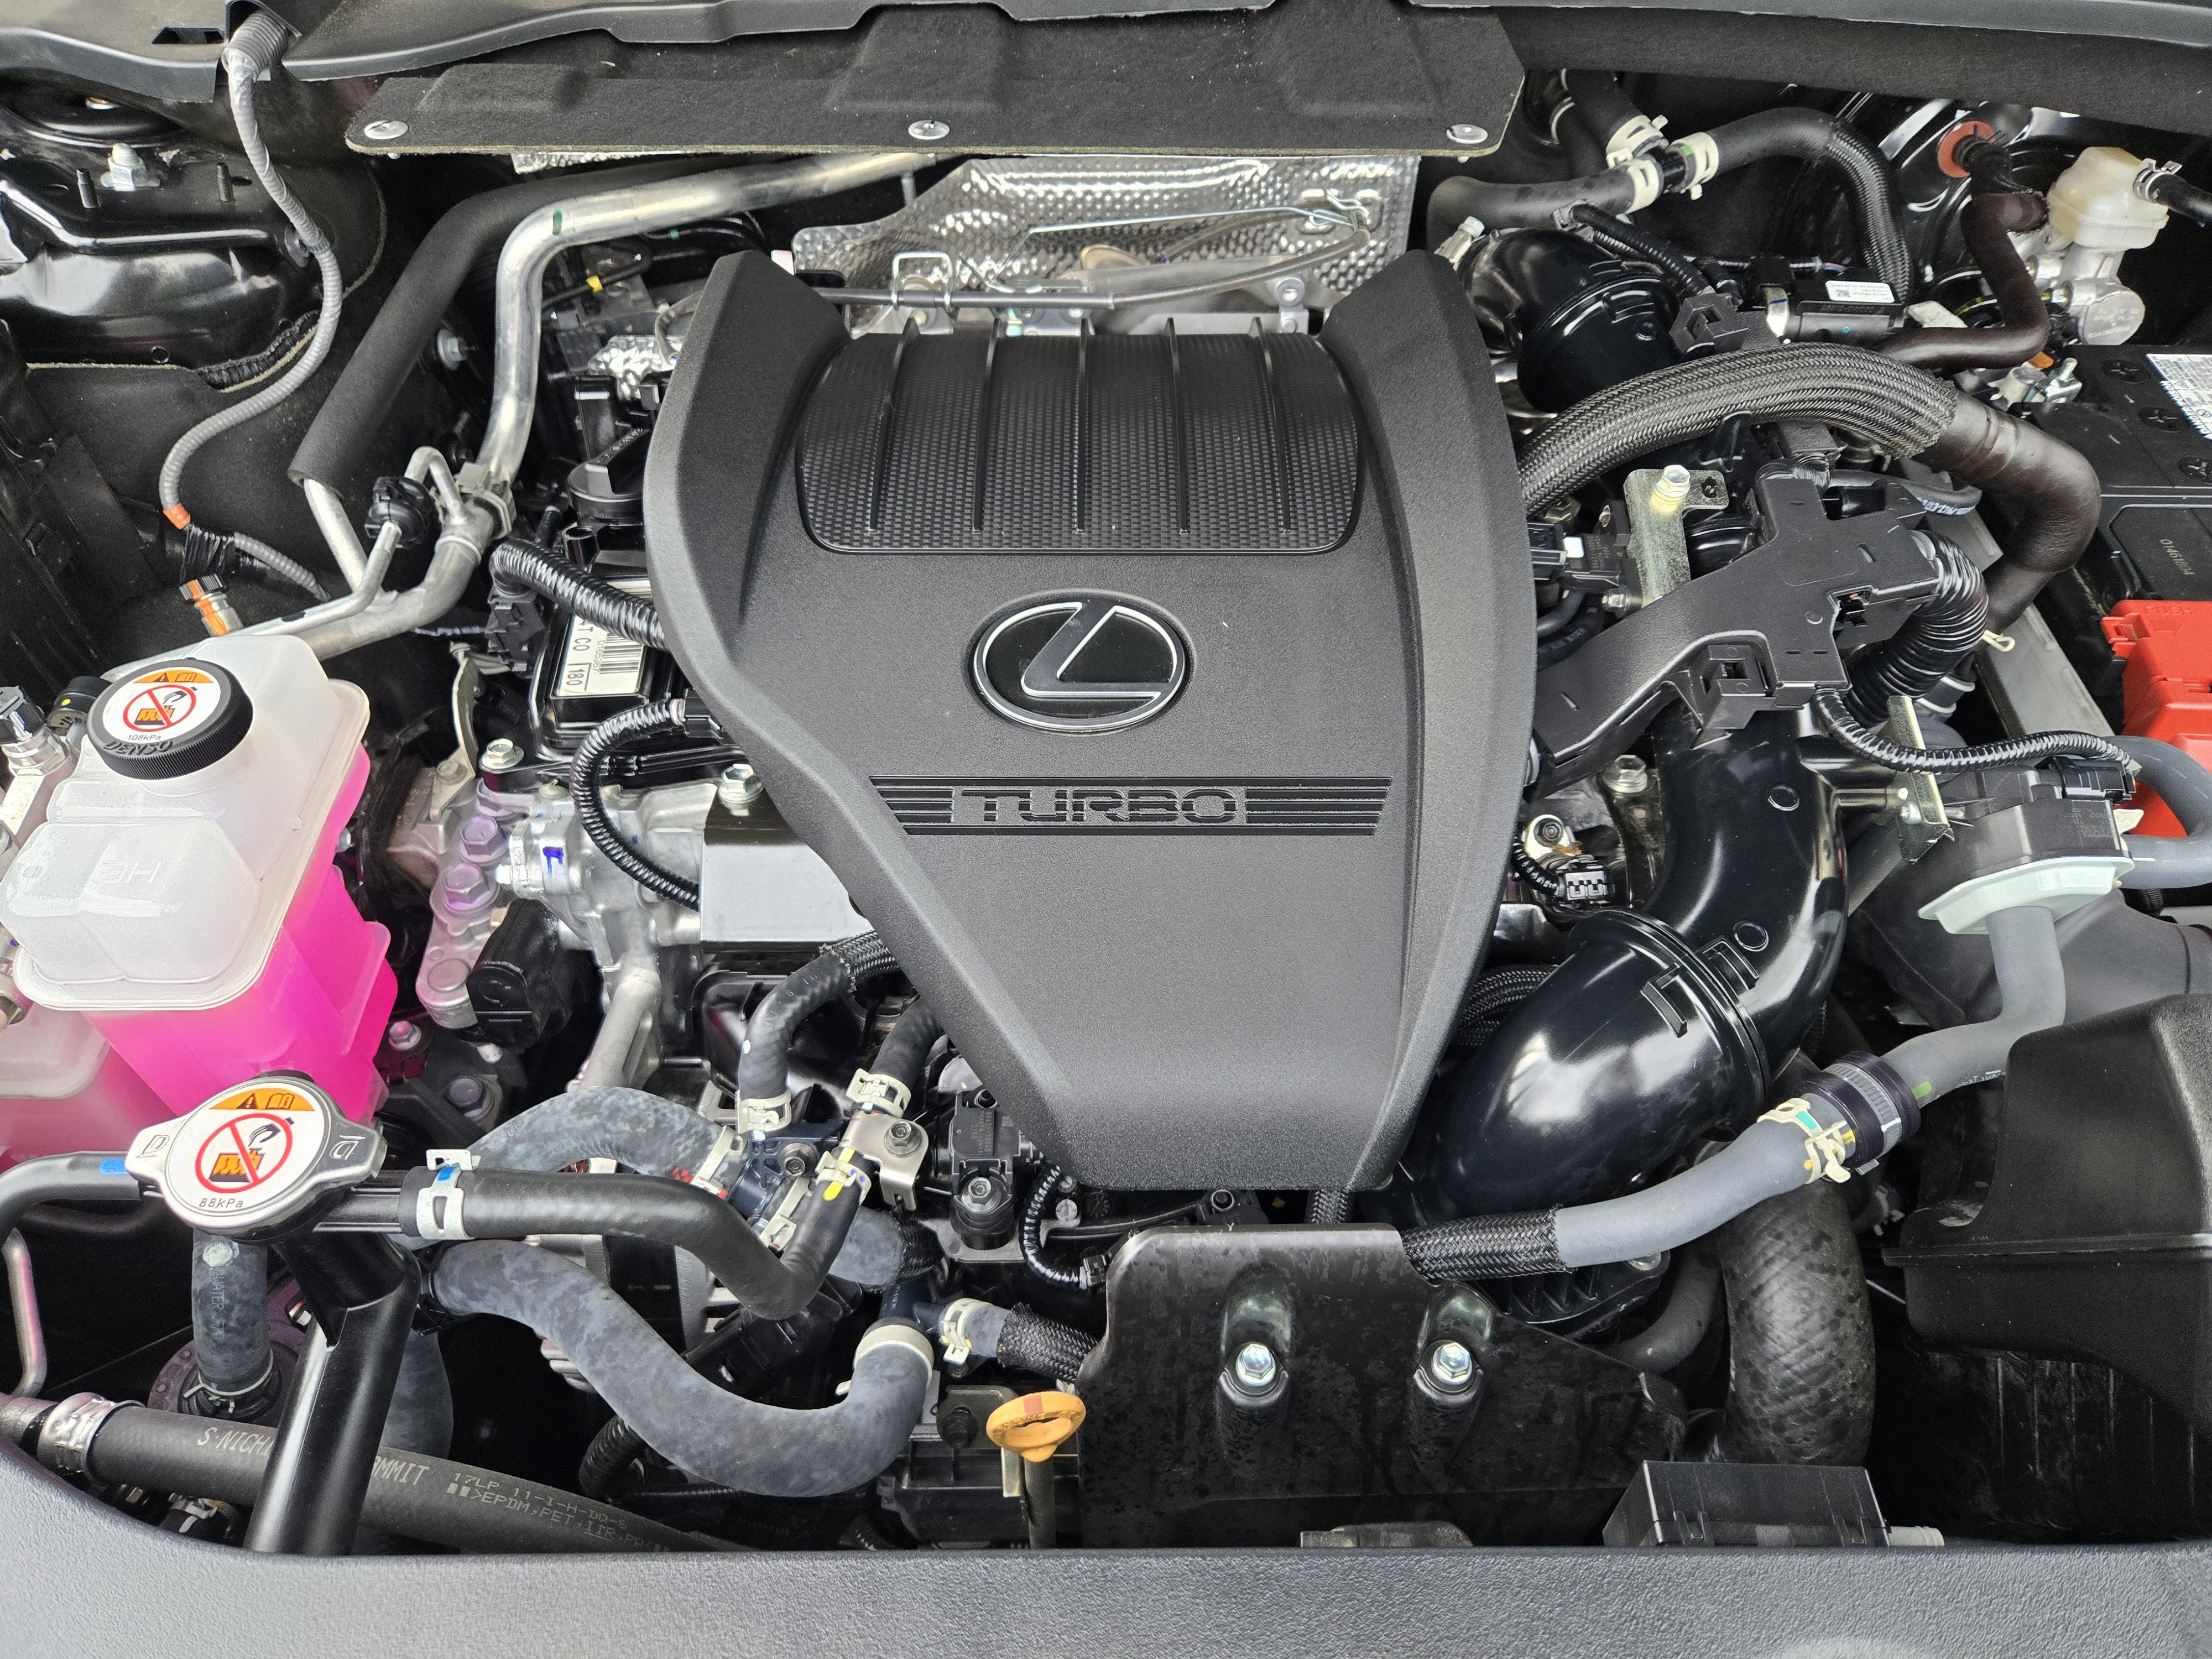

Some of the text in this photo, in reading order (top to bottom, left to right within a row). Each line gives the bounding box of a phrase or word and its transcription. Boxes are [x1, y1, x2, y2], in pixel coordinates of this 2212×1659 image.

[573, 638, 592, 651] CO
[592, 640, 606, 672] 0165367
[566, 668, 585, 686] 180
[103, 739, 174, 755] DENSO
[962, 789, 1238, 823] TURBO
[199, 1197, 243, 1208] 88kPa
[453, 1472, 500, 1489] 17LP
